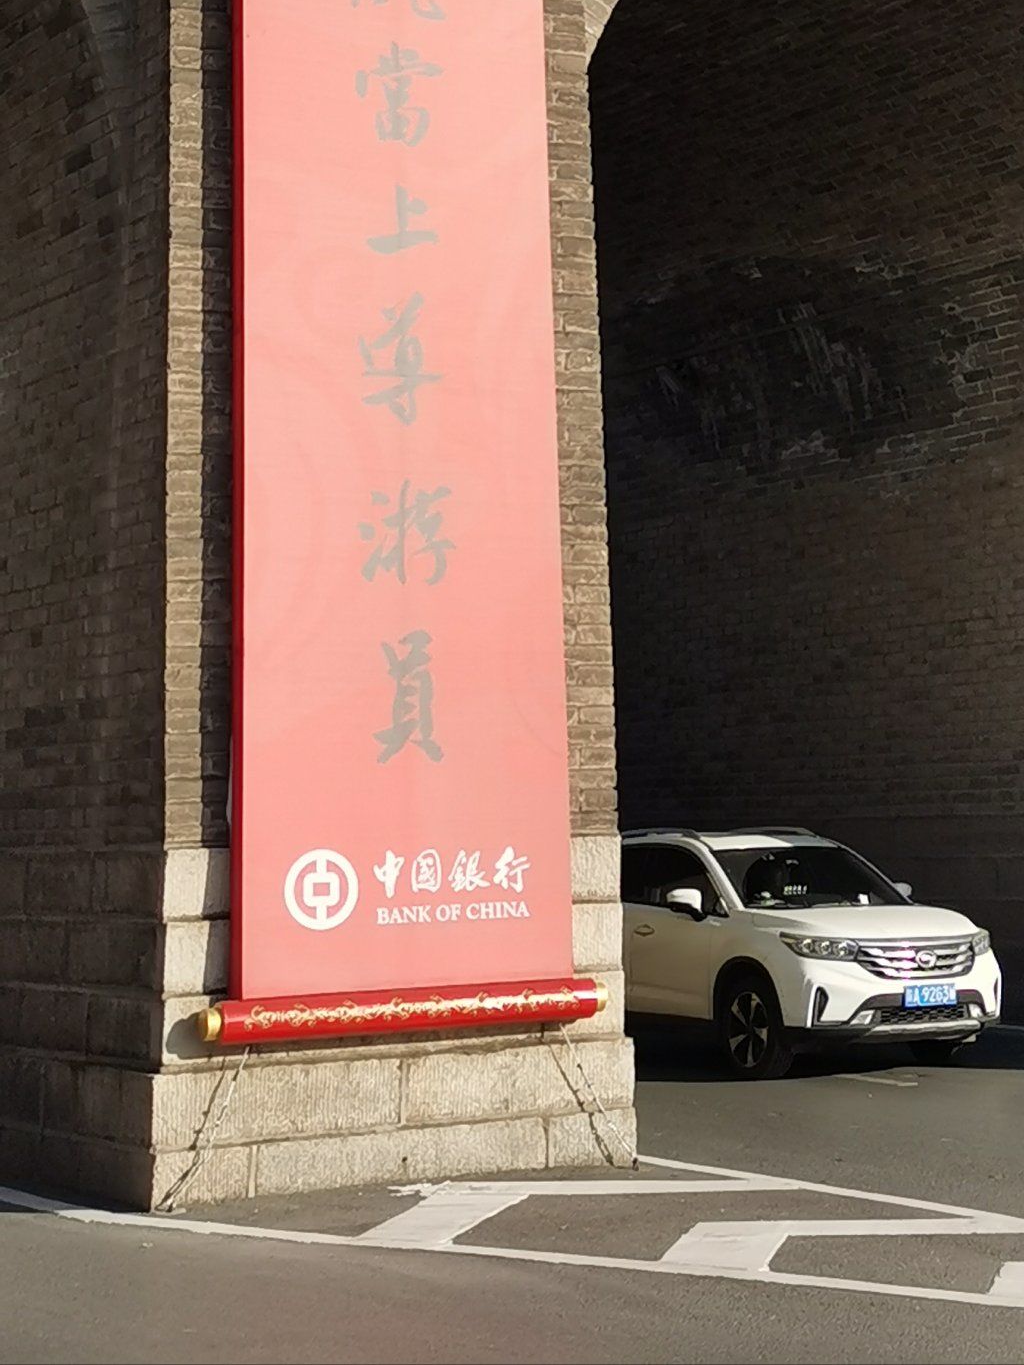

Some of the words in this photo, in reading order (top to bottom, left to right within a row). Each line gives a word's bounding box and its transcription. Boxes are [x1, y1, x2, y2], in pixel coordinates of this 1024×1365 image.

[377, 903, 432, 926] BANK
[435, 902, 462, 922] OF
[466, 899, 531, 921] CHINA
